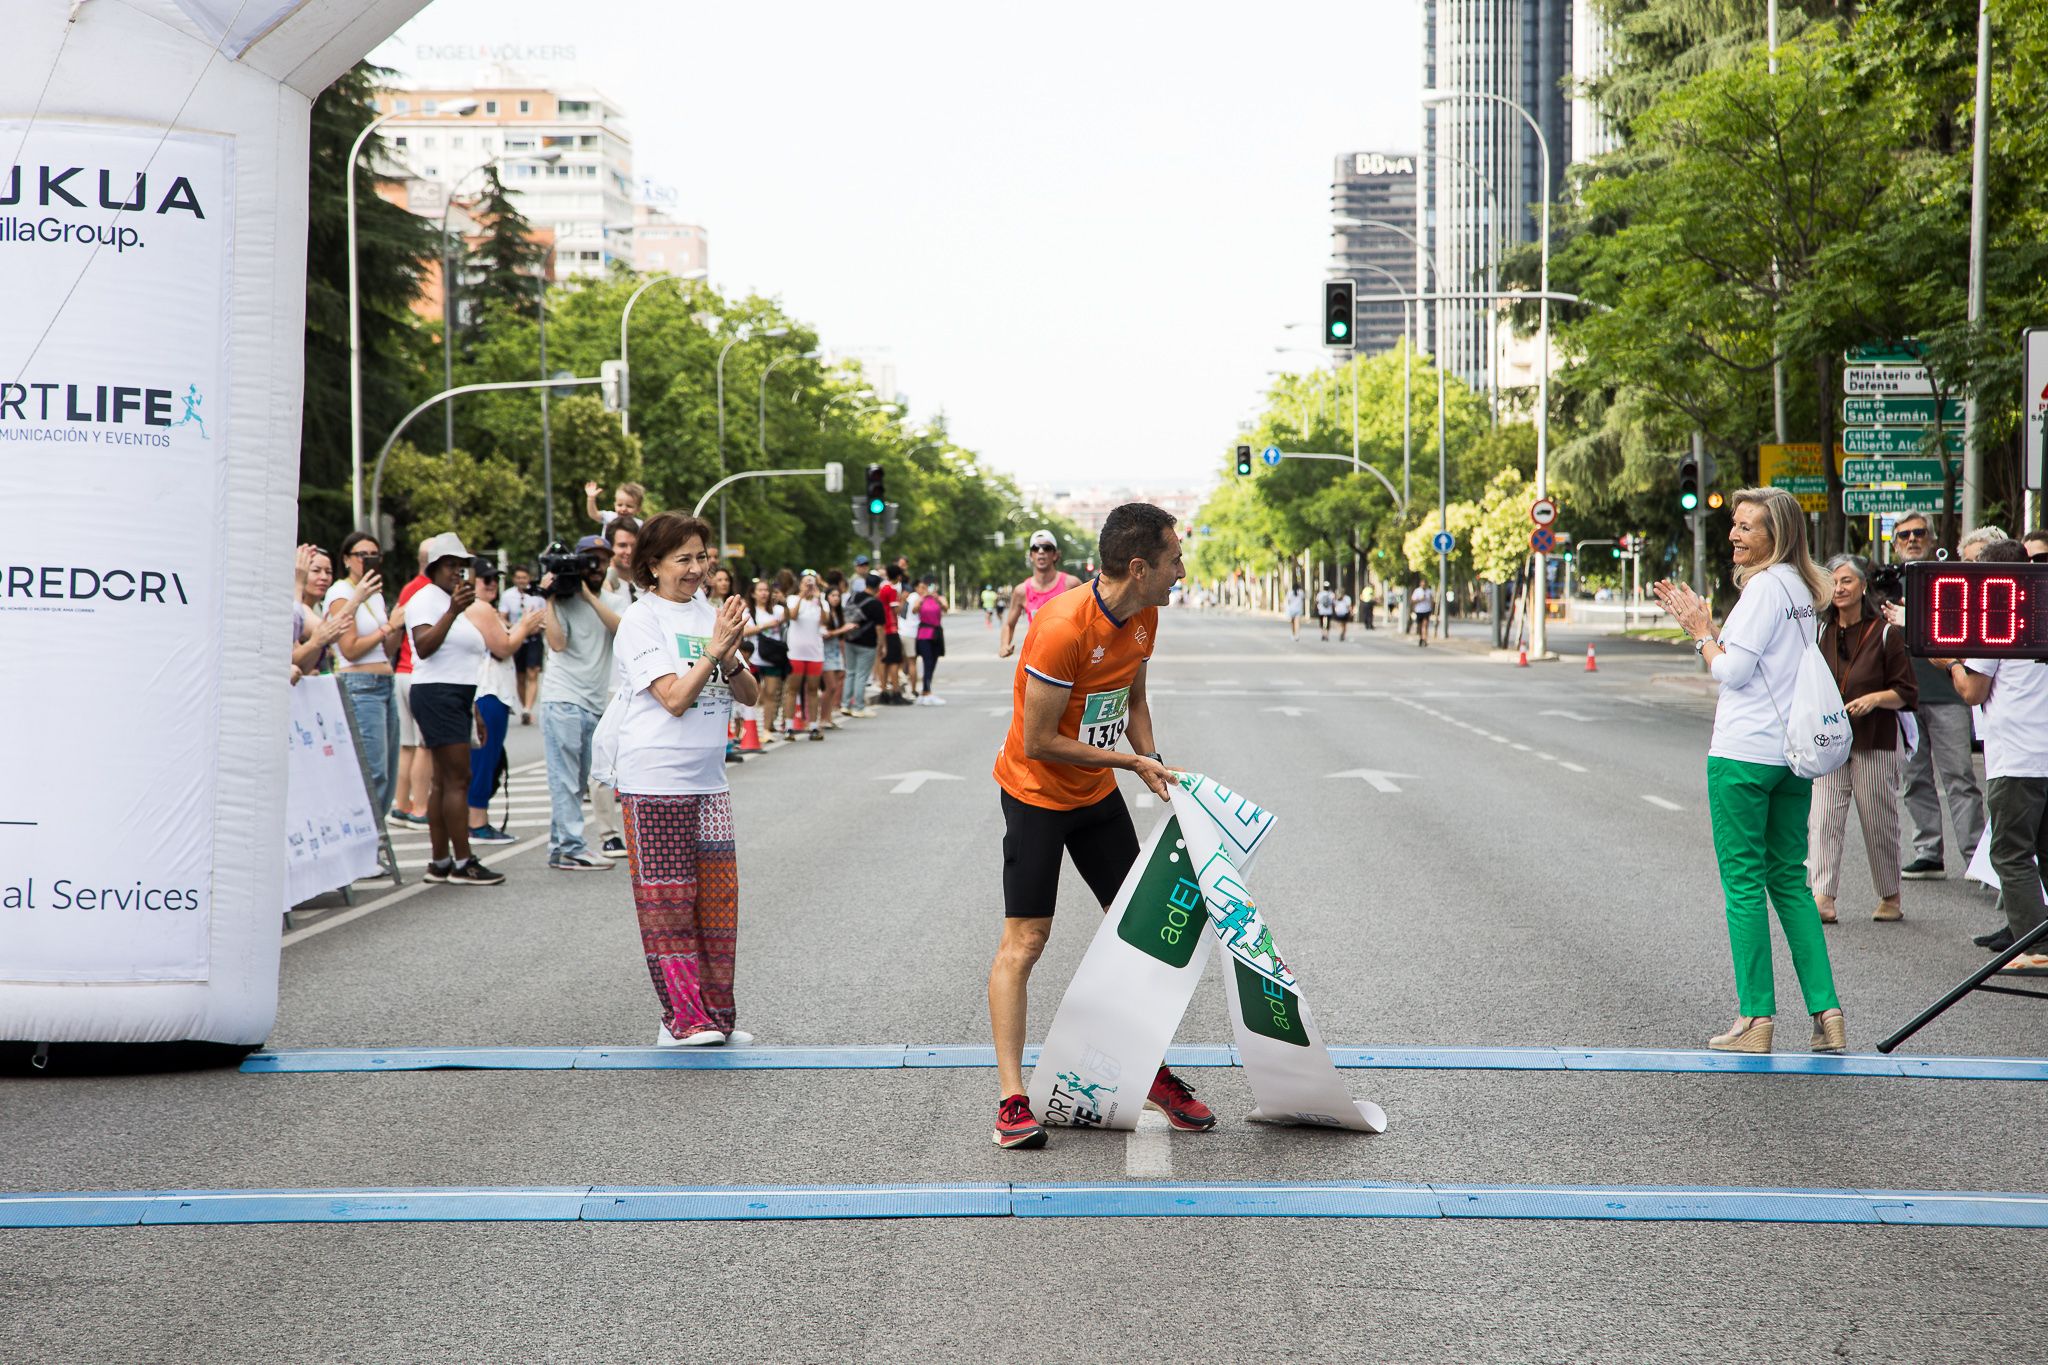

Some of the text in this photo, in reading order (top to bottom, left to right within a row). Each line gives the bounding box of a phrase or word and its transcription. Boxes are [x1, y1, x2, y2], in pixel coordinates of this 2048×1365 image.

[1355, 153, 1413, 175] BBVA
[1849, 371, 1929, 380] Ministerio de
[1849, 381, 1898, 390] Defensa
[1847, 400, 1885, 409] calle de
[1847, 409, 1928, 421] San Germán
[92, 431, 101, 442] Y
[105, 431, 170, 447] EVENTOS
[1848, 431, 1891, 440] calle de
[1848, 440, 1893, 450] Alberto
[1847, 462, 1895, 471] calle del
[1847, 471, 1882, 481] Padre
[1847, 492, 1905, 502] plaza de la
[1862, 501, 1933, 511] Dominicana
[1088, 718, 1125, 748] 1319
[3, 877, 199, 910] al Services
